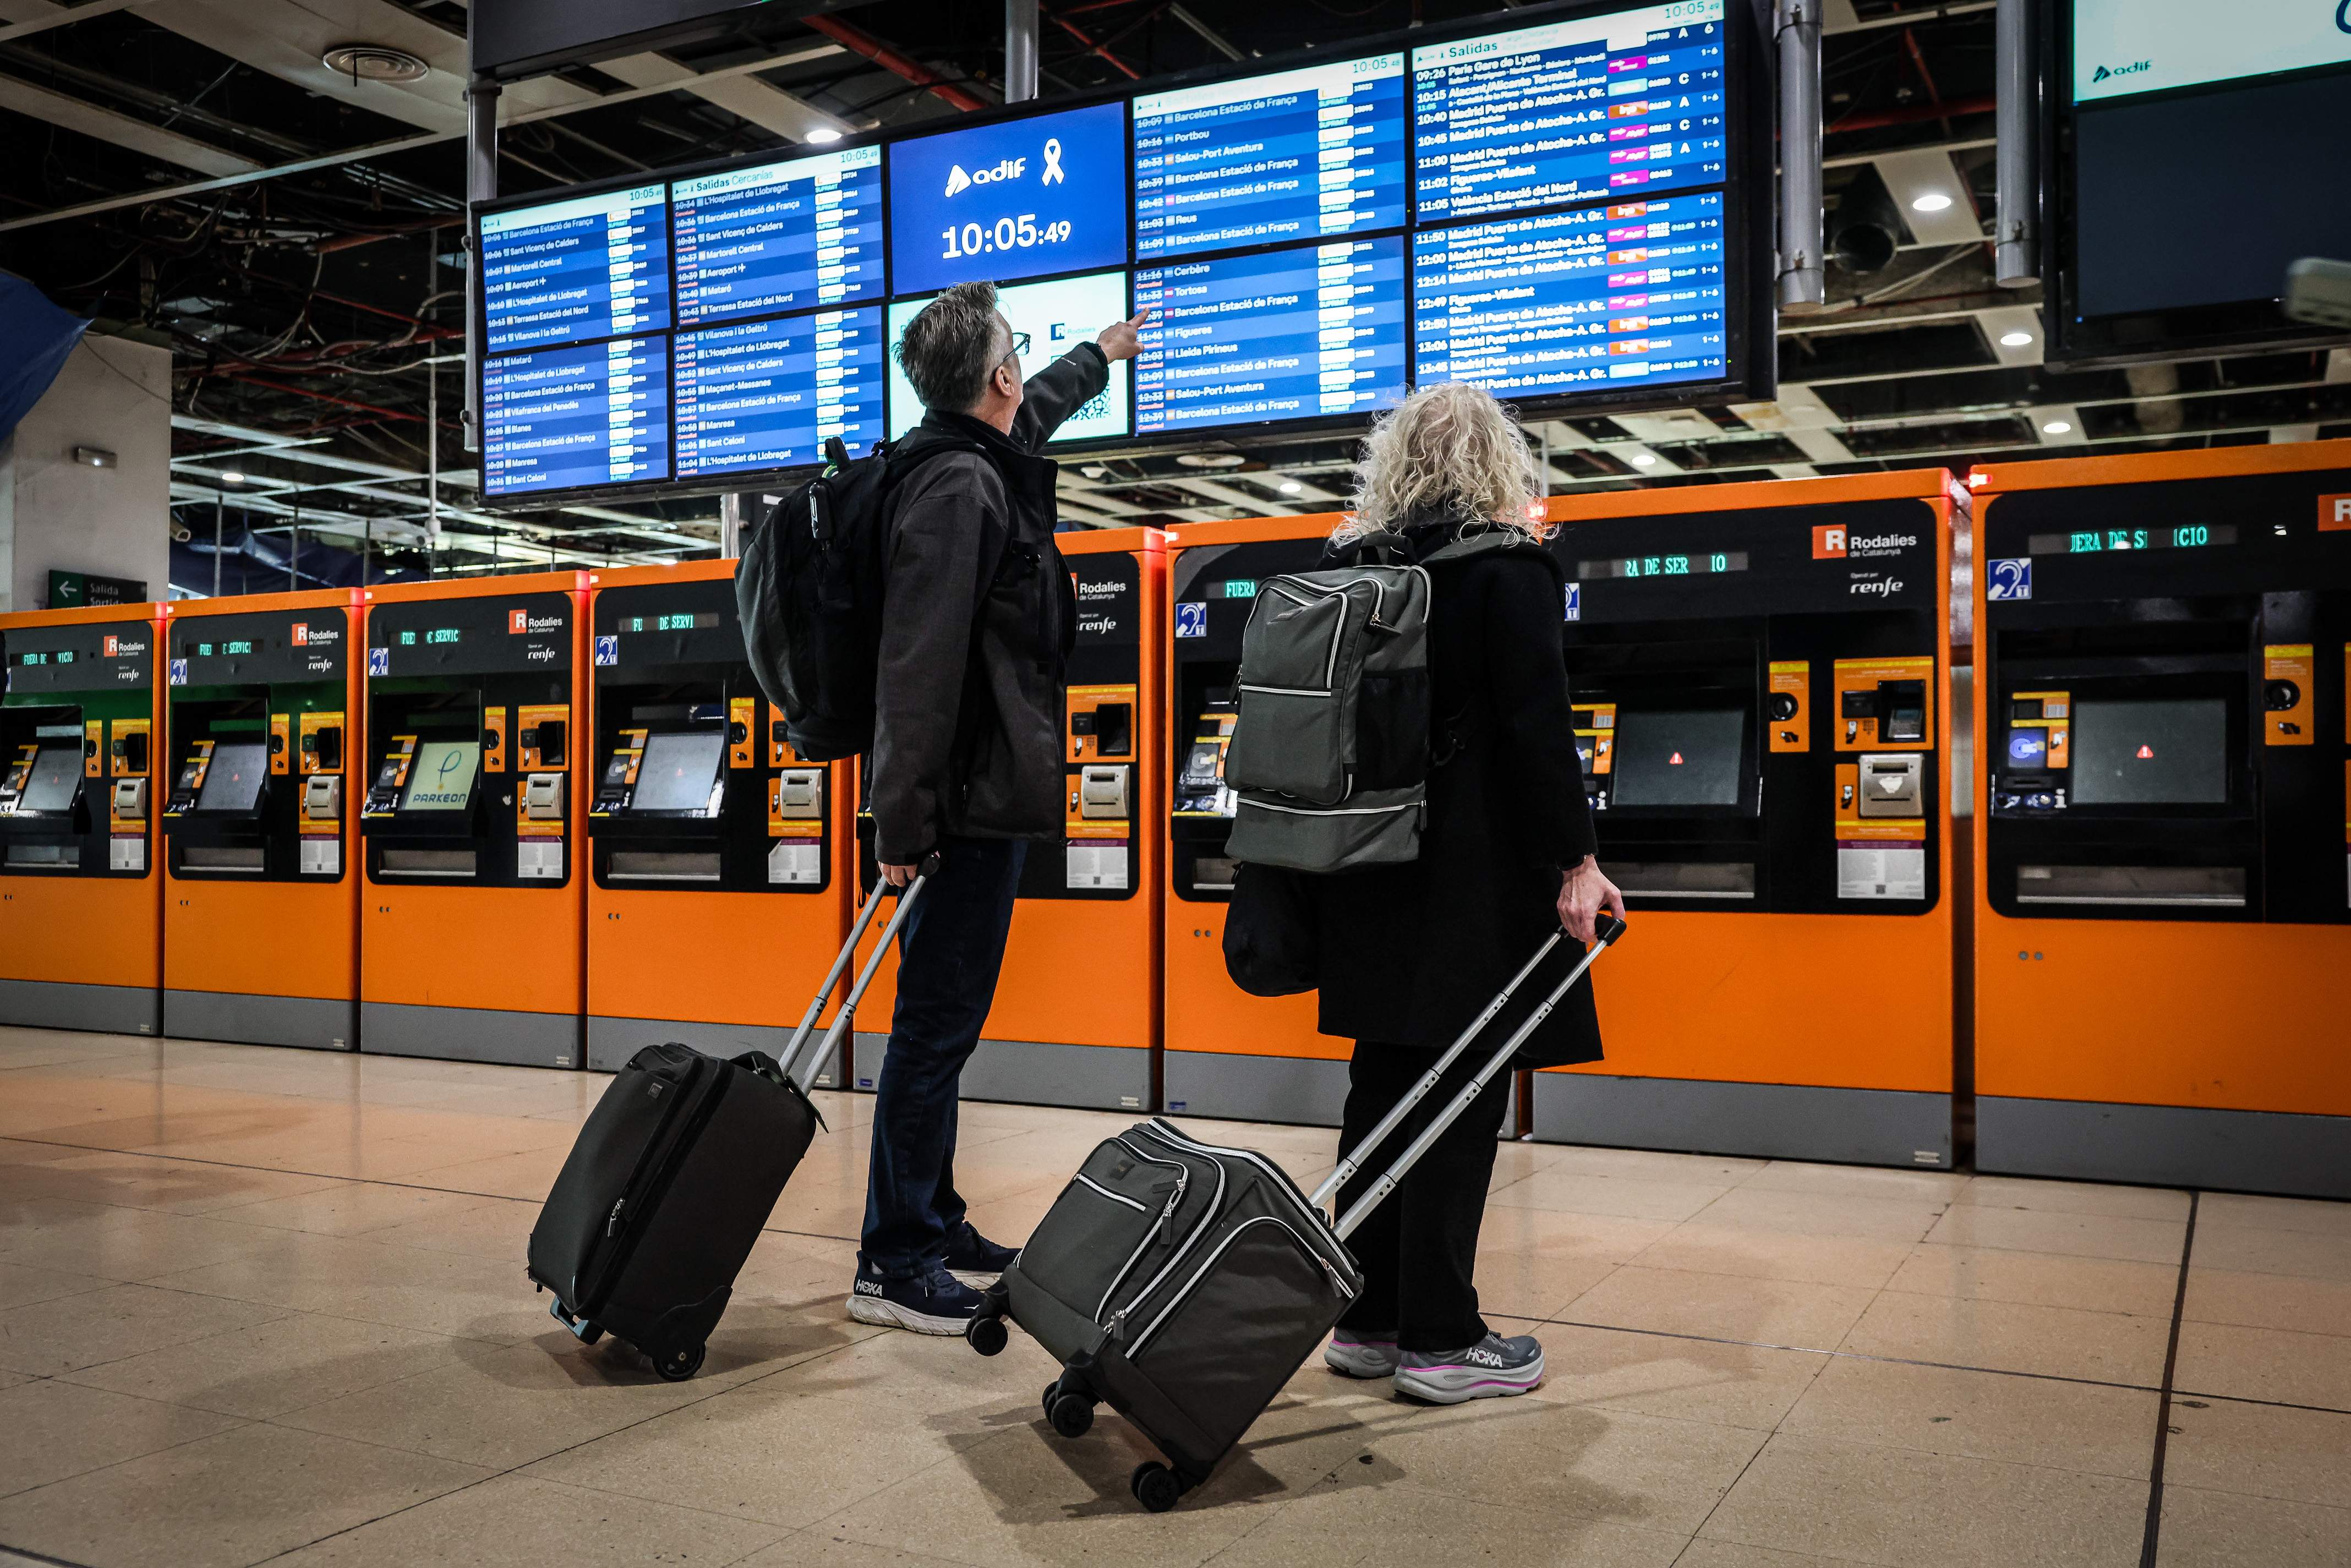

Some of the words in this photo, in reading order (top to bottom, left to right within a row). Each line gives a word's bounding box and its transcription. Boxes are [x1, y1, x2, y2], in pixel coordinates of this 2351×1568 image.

[1664, 1, 1704, 18] 10:05
[1678, 27, 1688, 39] A
[1705, 23, 1714, 34] 6
[1449, 42, 1497, 57] Salidas
[1353, 58, 1387, 73] 10:05
[1417, 68, 1446, 82] 09:26
[1474, 60, 1499, 72] Gare
[1500, 57, 1513, 68] de
[1515, 53, 1540, 67] Lyon
[2114, 59, 2152, 76] adif
[1417, 89, 1446, 103] 10:15
[1533, 68, 1577, 84] Terminal
[1678, 73, 1690, 84] C
[1174, 110, 1217, 122] Barcelona
[1219, 102, 1251, 114] Estació
[1253, 100, 1265, 110] de
[1266, 95, 1298, 107] França
[1417, 111, 1447, 125] 10:40
[1449, 105, 1484, 120] Madrid
[1485, 101, 1519, 114] Puerta
[1520, 98, 1534, 109] de
[1588, 87, 1605, 99] Gr.
[1679, 96, 1690, 108] A
[1418, 133, 1447, 147] 10:45
[1449, 127, 1485, 142] Madrid
[1486, 123, 1519, 136] Puerta
[1520, 121, 1534, 131] de
[1589, 111, 1606, 121] Gr.
[1680, 119, 1690, 130] C
[1174, 130, 1210, 143] Portbou
[1174, 149, 1222, 163] Salou-Port
[1223, 142, 1264, 156] Aventura
[1418, 155, 1448, 169] 11:00
[1450, 149, 1485, 164] Madrid
[1486, 145, 1519, 159] Puerta
[1521, 142, 1534, 154] de
[1589, 132, 1606, 143] Gr.
[1680, 142, 1691, 154] A
[841, 149, 868, 163] 10:05
[972, 157, 1026, 184] adif
[697, 176, 730, 191] Salidas
[731, 169, 773, 184] Cercanías
[1419, 177, 1448, 190] 11:02
[630, 188, 654, 200] 10:05
[744, 189, 754, 198] de
[754, 183, 789, 196] Llobregat
[1419, 198, 1448, 212] 11:05
[1494, 187, 1531, 202] Estació
[1533, 184, 1550, 196] del
[1551, 181, 1577, 193] Nord
[509, 226, 539, 238] Barcelona
[540, 222, 562, 233] Estació
[572, 218, 593, 227] França
[706, 232, 721, 242] Sant
[746, 225, 755, 233] de
[756, 221, 783, 232] Calders
[1416, 231, 1446, 245] 11:50
[1448, 226, 1483, 241] Madrid
[1484, 221, 1517, 236] Puerta
[1518, 219, 1533, 230] de
[1587, 210, 1604, 221] Gr.
[942, 213, 1071, 259] 10:05:49
[706, 247, 737, 259] Martorell
[738, 242, 764, 254] Central
[707, 285, 731, 295] Mataró
[1174, 285, 1207, 296] Tortosa
[1417, 296, 1446, 309] 12:49
[1174, 326, 1212, 338] Figueres
[1175, 347, 1202, 358] Lleida
[1176, 385, 1223, 399] Salou-Port
[1224, 381, 1265, 393] Aventura
[706, 419, 735, 430] Manresa
[2334, 499, 2351, 522] R
[1825, 529, 1846, 550] R
[1850, 534, 1917, 549] Rodalies
[1862, 548, 1901, 557] Catalunya
[1644, 558, 1660, 575] DE
[90, 583, 118, 595] Salida
[1079, 581, 1127, 593] Rodalies
[1226, 581, 1255, 598] FUERA
[1850, 576, 1904, 598] renfe
[516, 613, 526, 629] R
[528, 617, 562, 627] Rodalies
[660, 616, 669, 630] DE
[1079, 616, 1117, 634] renfe
[298, 626, 307, 641] R
[309, 631, 338, 640] Rodalies
[109, 638, 117, 652] R
[118, 643, 145, 651] Rodalies
[24, 653, 38, 665] FUERA
[40, 654, 47, 664] DE
[528, 647, 555, 663] renfe
[308, 659, 332, 673] renfe
[118, 669, 139, 682] renfe
[413, 793, 467, 802] PARKEON
[856, 1279, 882, 1297] HOKA
[1466, 1347, 1503, 1368] HOKA
